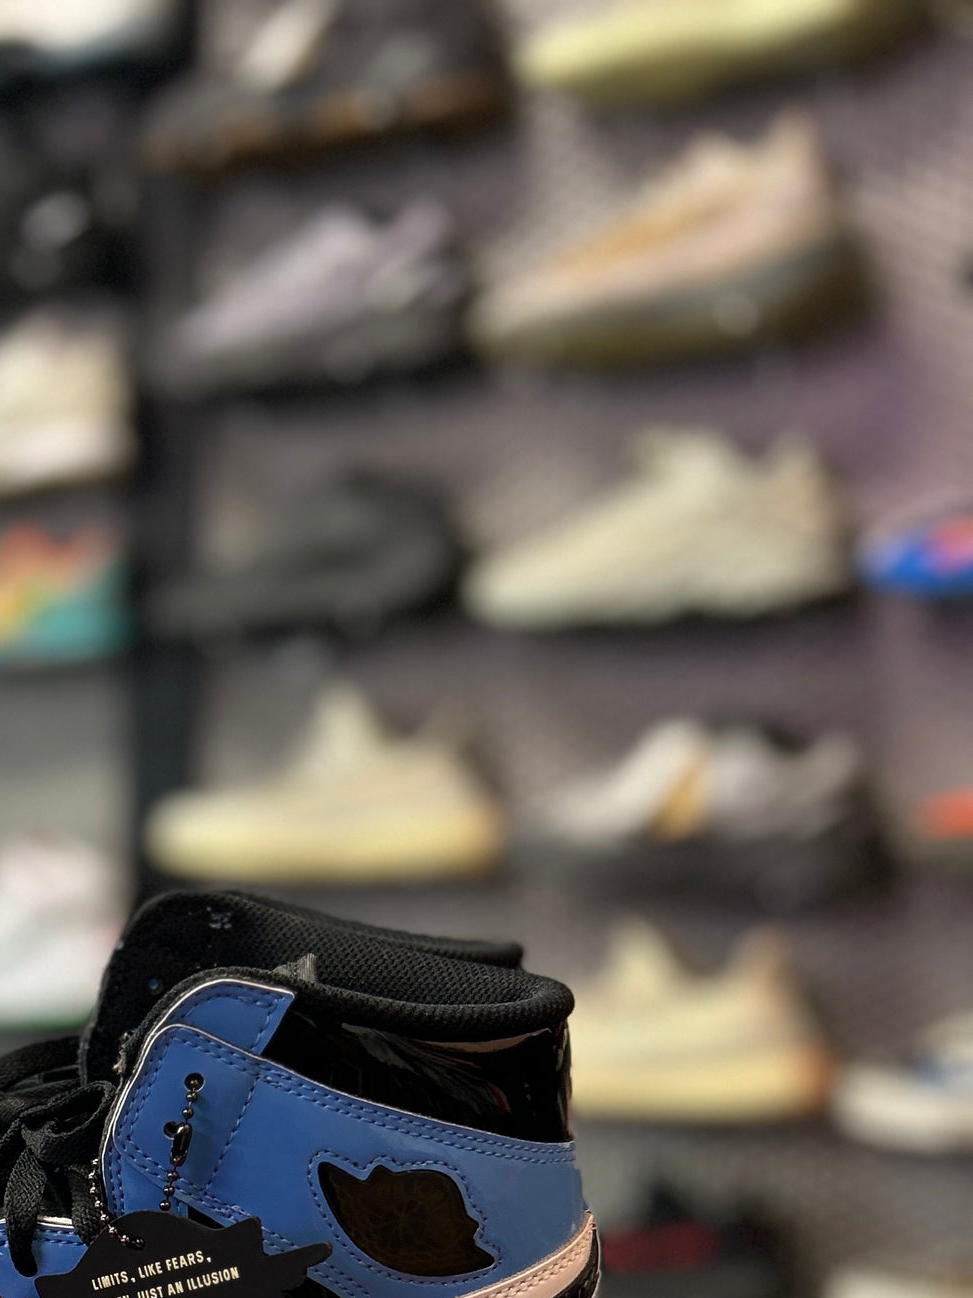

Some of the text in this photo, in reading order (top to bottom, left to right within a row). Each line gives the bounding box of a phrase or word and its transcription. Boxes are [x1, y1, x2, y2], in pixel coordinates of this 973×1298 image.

[91, 1250, 212, 1291] LIMITS, LIKE FEARS,
[167, 1280, 184, 1296] AN
[187, 1266, 240, 1291] ILLUSION
